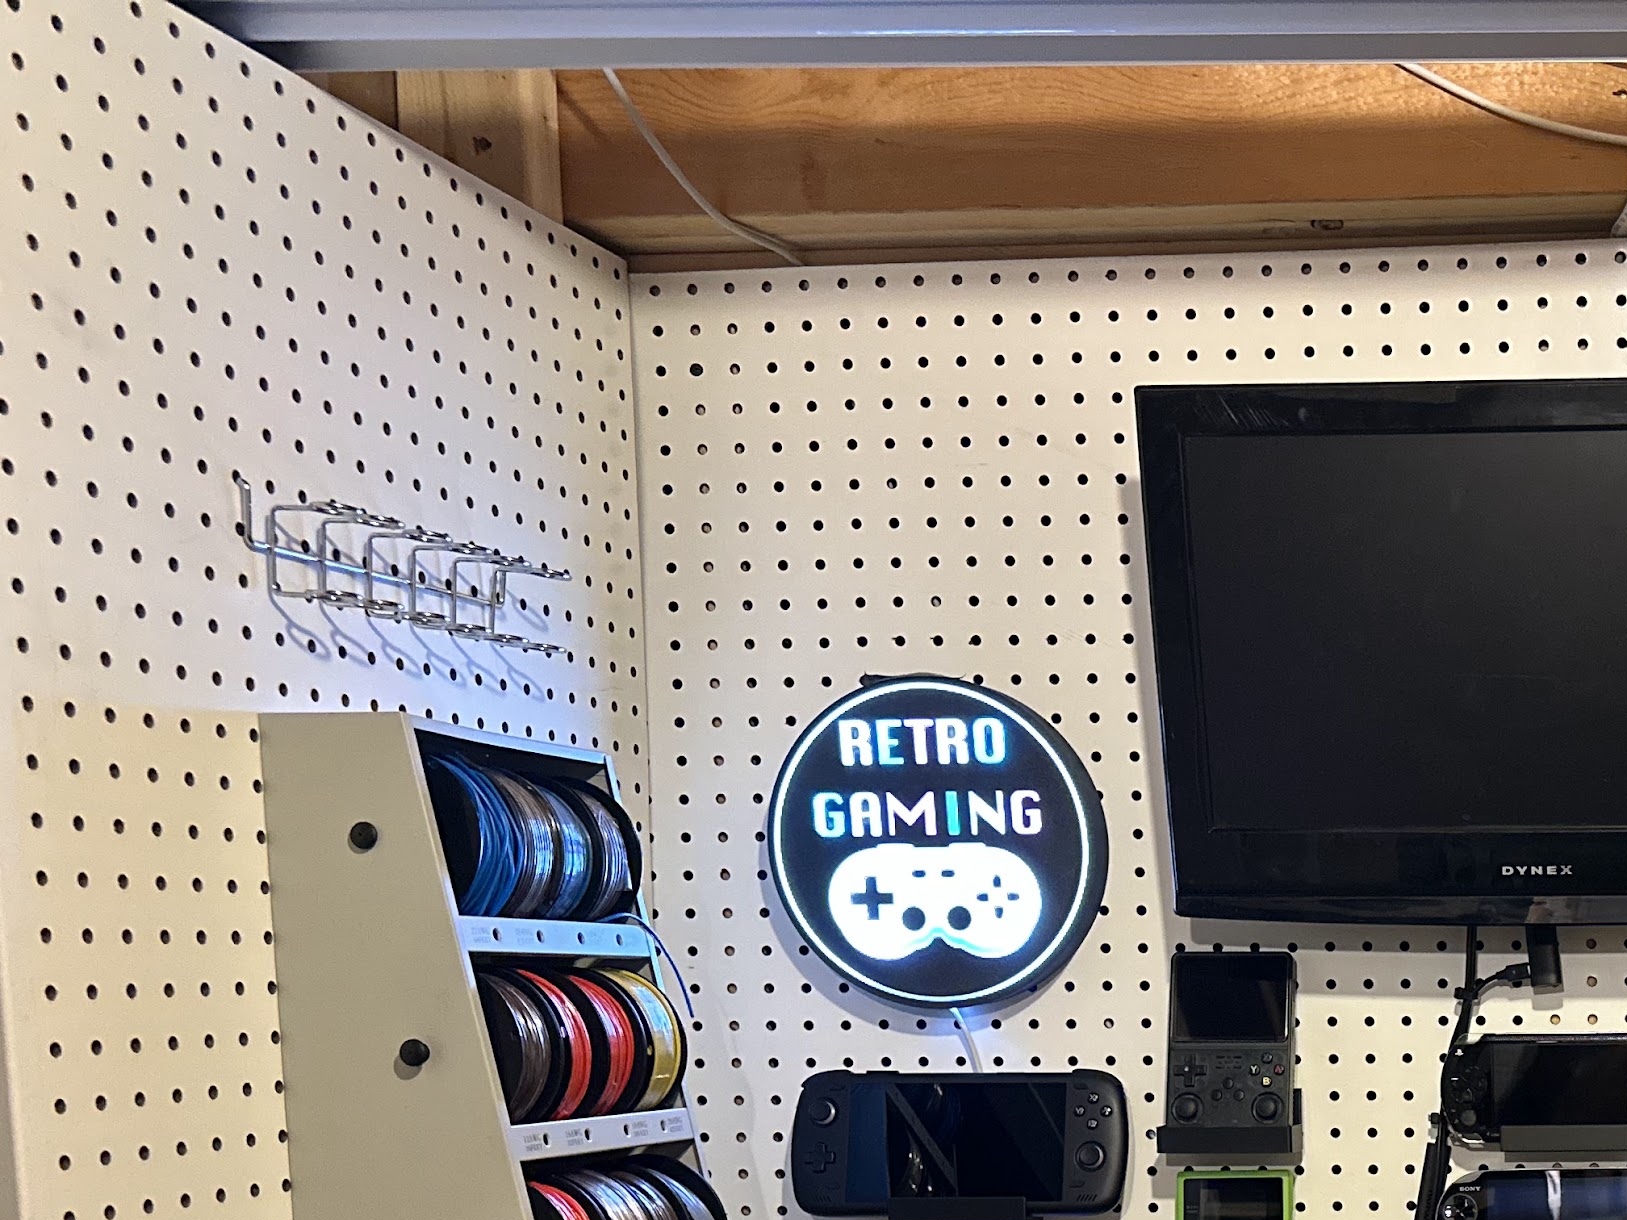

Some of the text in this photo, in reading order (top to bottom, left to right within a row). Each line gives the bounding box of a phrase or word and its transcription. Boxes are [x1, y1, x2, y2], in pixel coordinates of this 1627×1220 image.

[838, 717, 1006, 767] RETRO
[812, 789, 1043, 839] GAMING
[1501, 865, 1574, 876] DYNEX
[1250, 1065, 1258, 1074] Y
[1262, 1077, 1271, 1086] B
